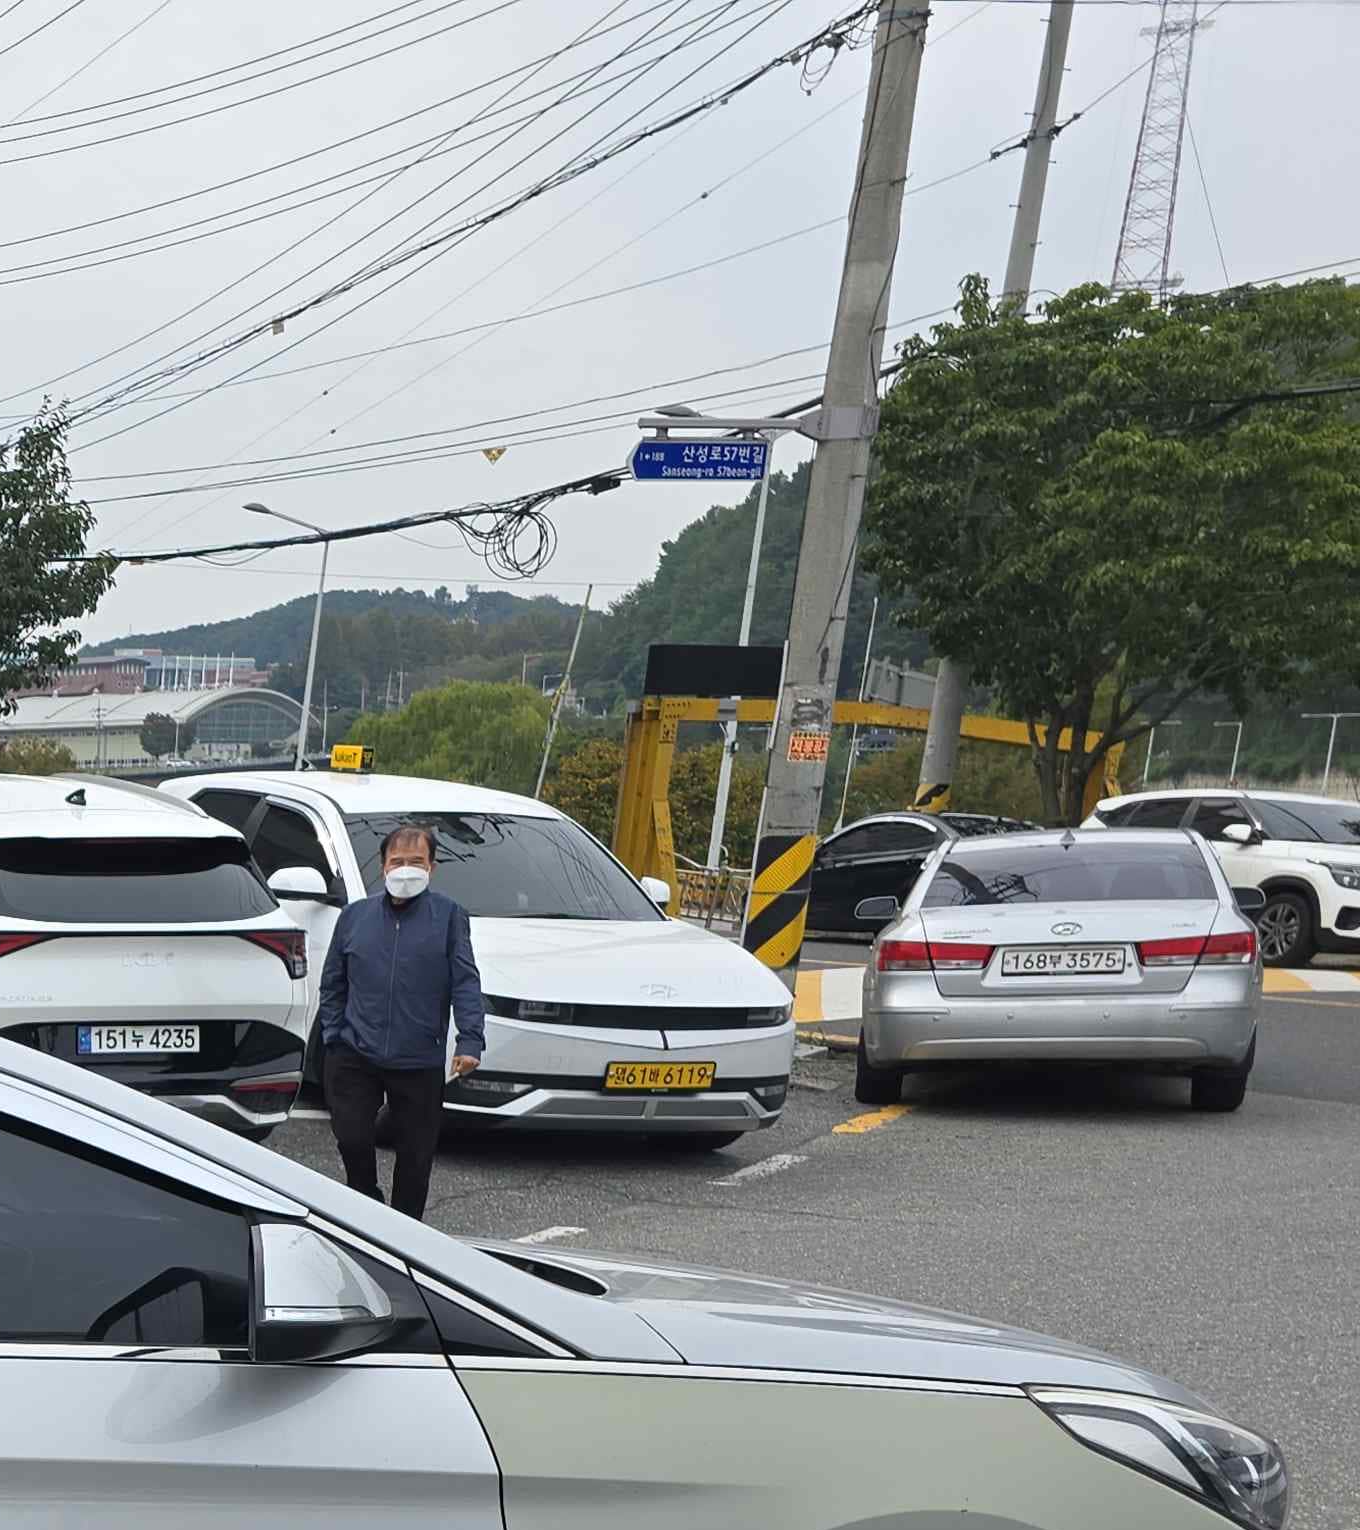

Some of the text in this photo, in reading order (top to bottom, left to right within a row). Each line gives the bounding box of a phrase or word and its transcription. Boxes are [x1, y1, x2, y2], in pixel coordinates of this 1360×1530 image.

[682, 445, 764, 464] 산성로57번길
[661, 466, 714, 478] Sanseong-ro
[1011, 952, 1117, 969] 168부 3575
[94, 1028, 195, 1049] 151누 4235
[664, 1067, 707, 1085] 6119
